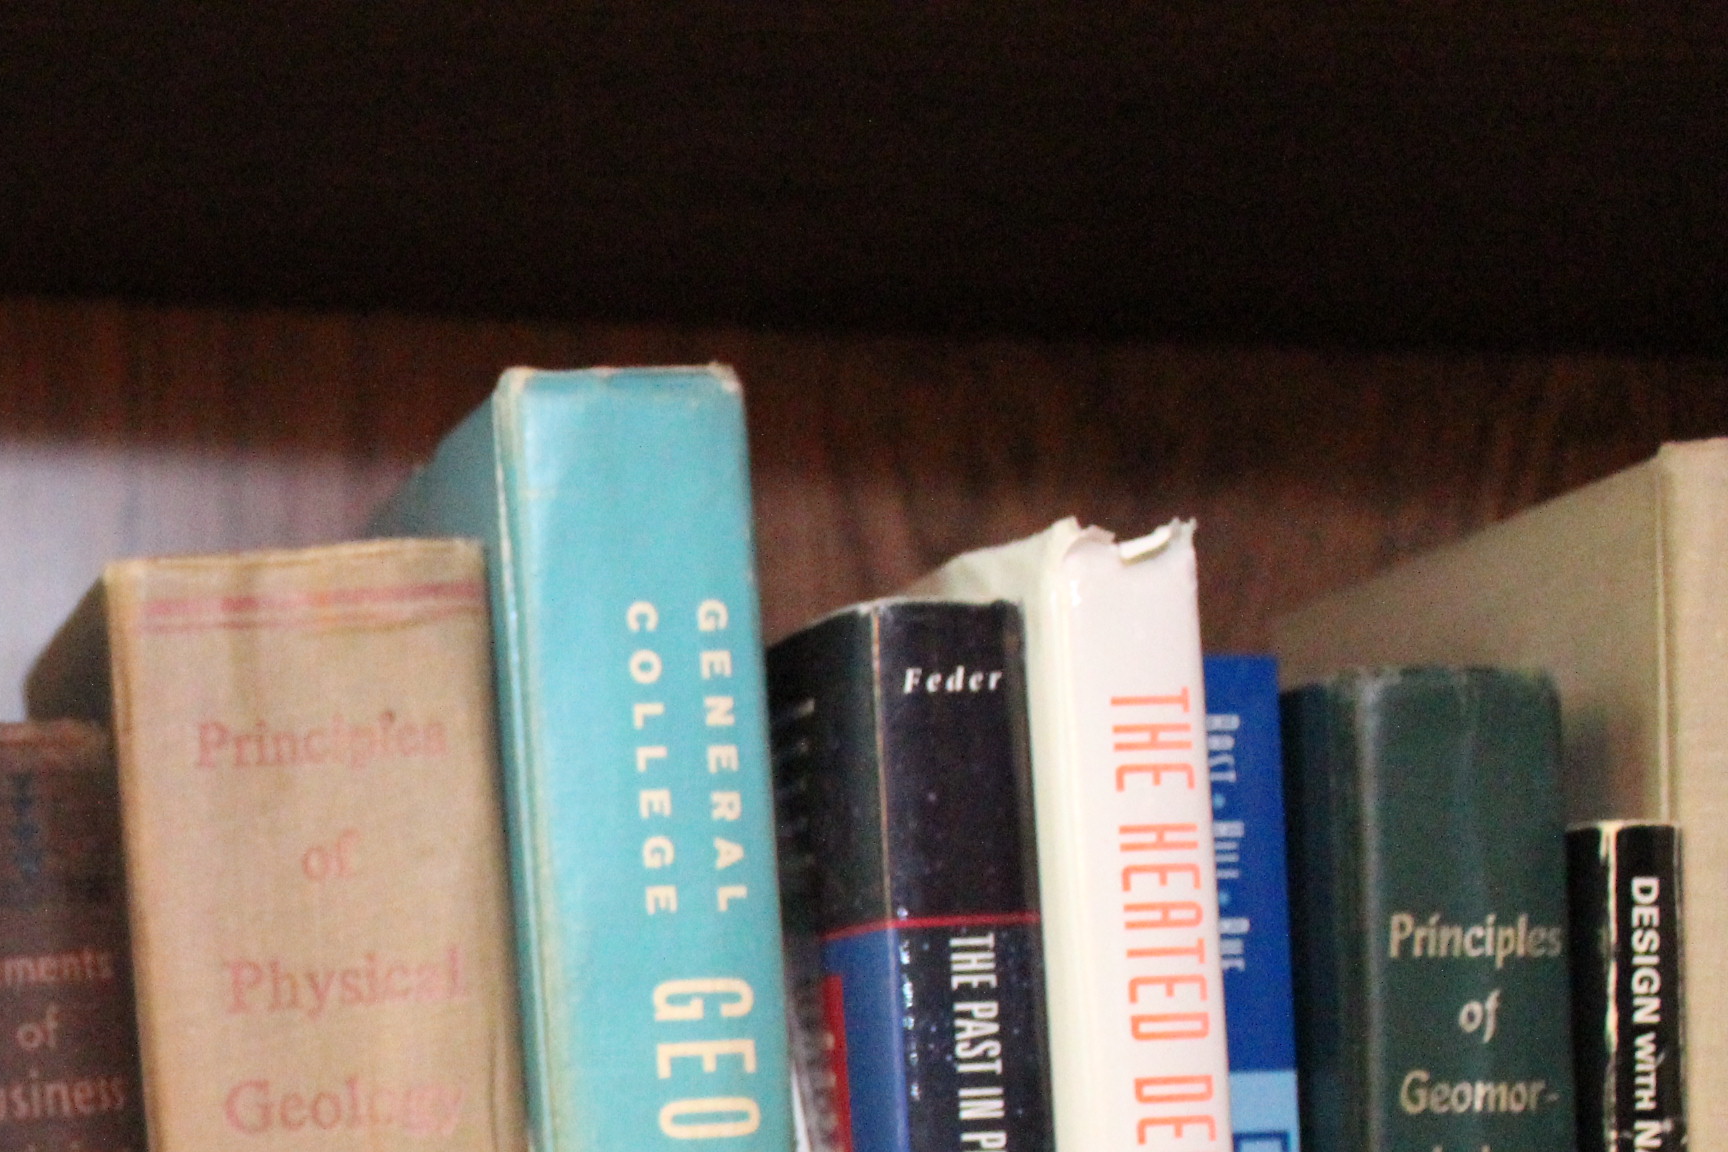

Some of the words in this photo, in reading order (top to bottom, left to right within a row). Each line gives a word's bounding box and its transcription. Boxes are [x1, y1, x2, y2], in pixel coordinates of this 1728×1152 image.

[903, 665, 1003, 695] Feder
[195, 714, 449, 770] Principles
[626, 601, 678, 915] COLLEGE
[696, 599, 748, 913] GENERAL
[1110, 686, 1196, 793] THE
[302, 827, 360, 882] of
[1118, 822, 1210, 1043] HEATED
[1388, 912, 1563, 968] Principles
[1631, 876, 1660, 1024] DESIGN
[223, 943, 466, 1022] Physical
[949, 934, 997, 990] THE
[17, 1004, 59, 1050] of
[953, 1000, 1003, 1075] PAST
[1459, 988, 1500, 1043] of
[959, 1087, 1005, 1121] IN
[1400, 1070, 1560, 1115] Geomor-
